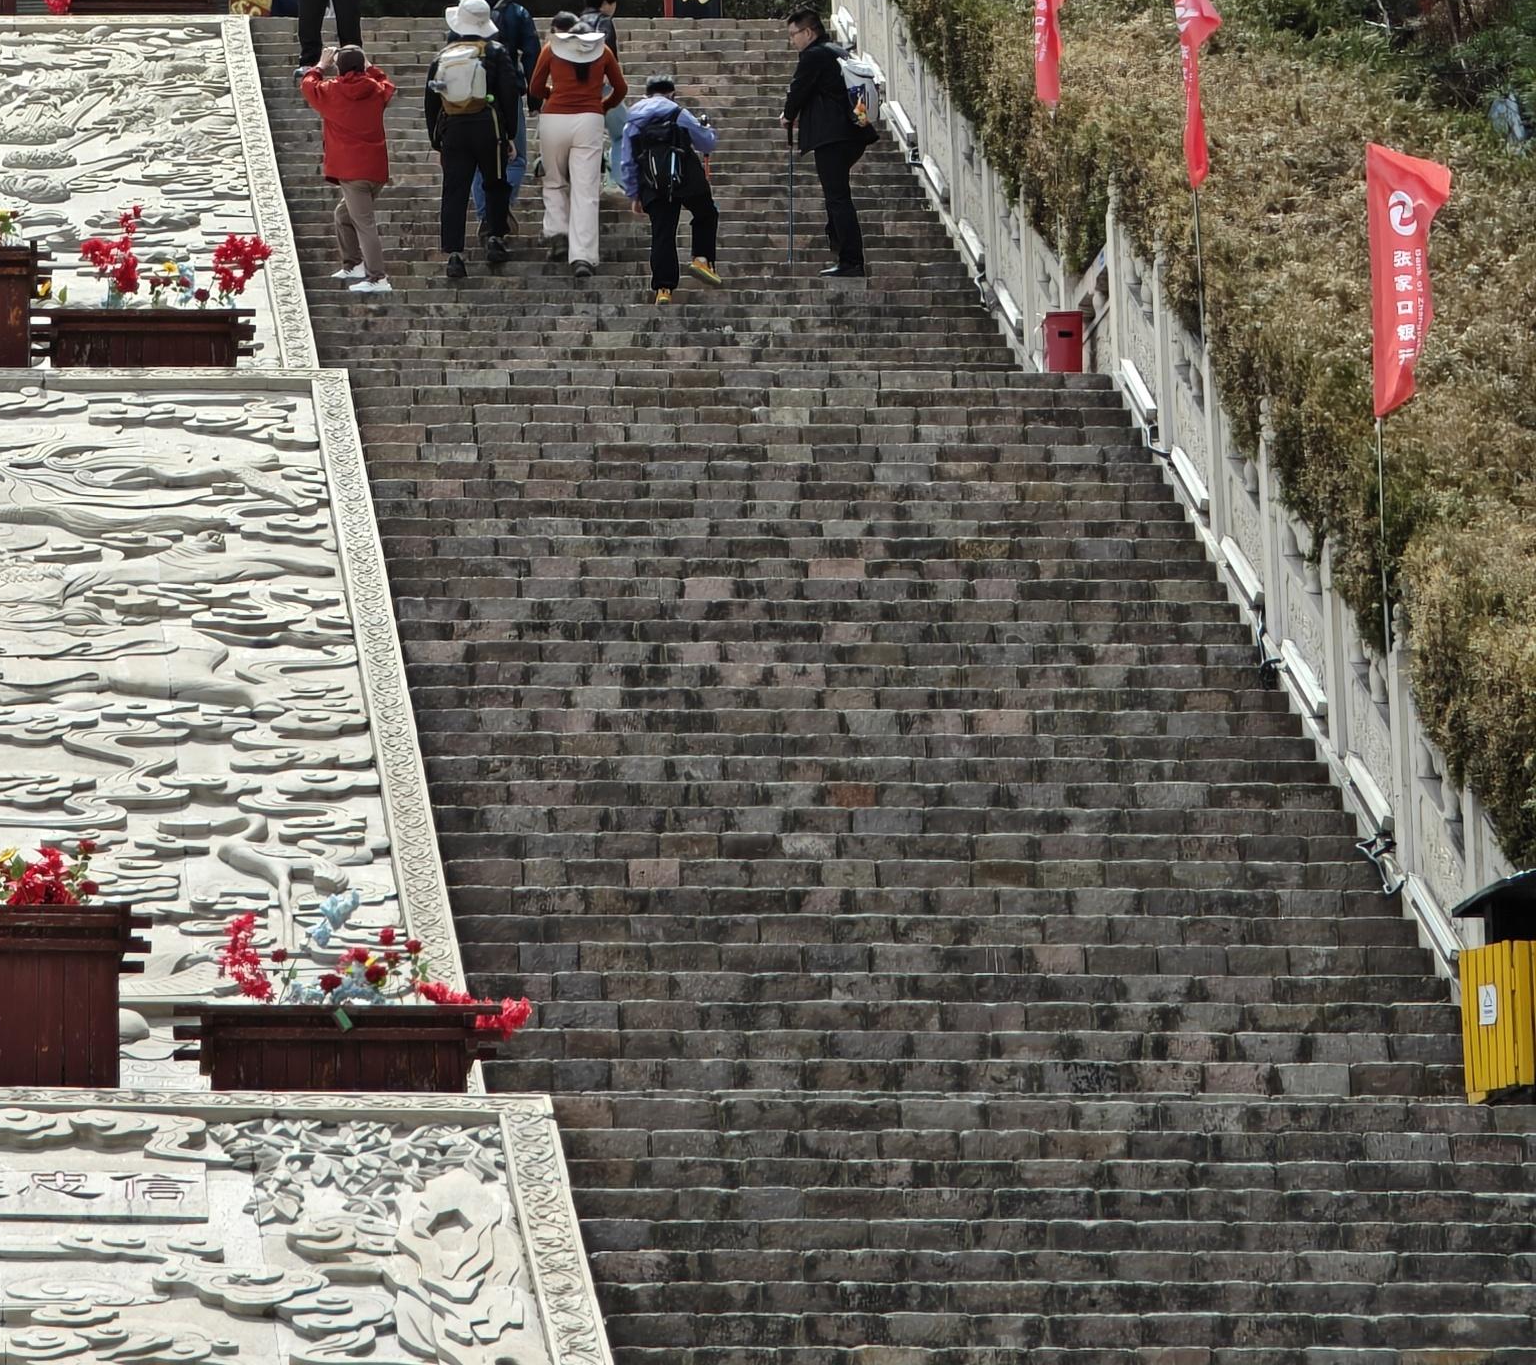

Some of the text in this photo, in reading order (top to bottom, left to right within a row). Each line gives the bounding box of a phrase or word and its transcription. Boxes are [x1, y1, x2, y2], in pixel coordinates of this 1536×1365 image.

[1394, 250, 1416, 365] 张家口银行
